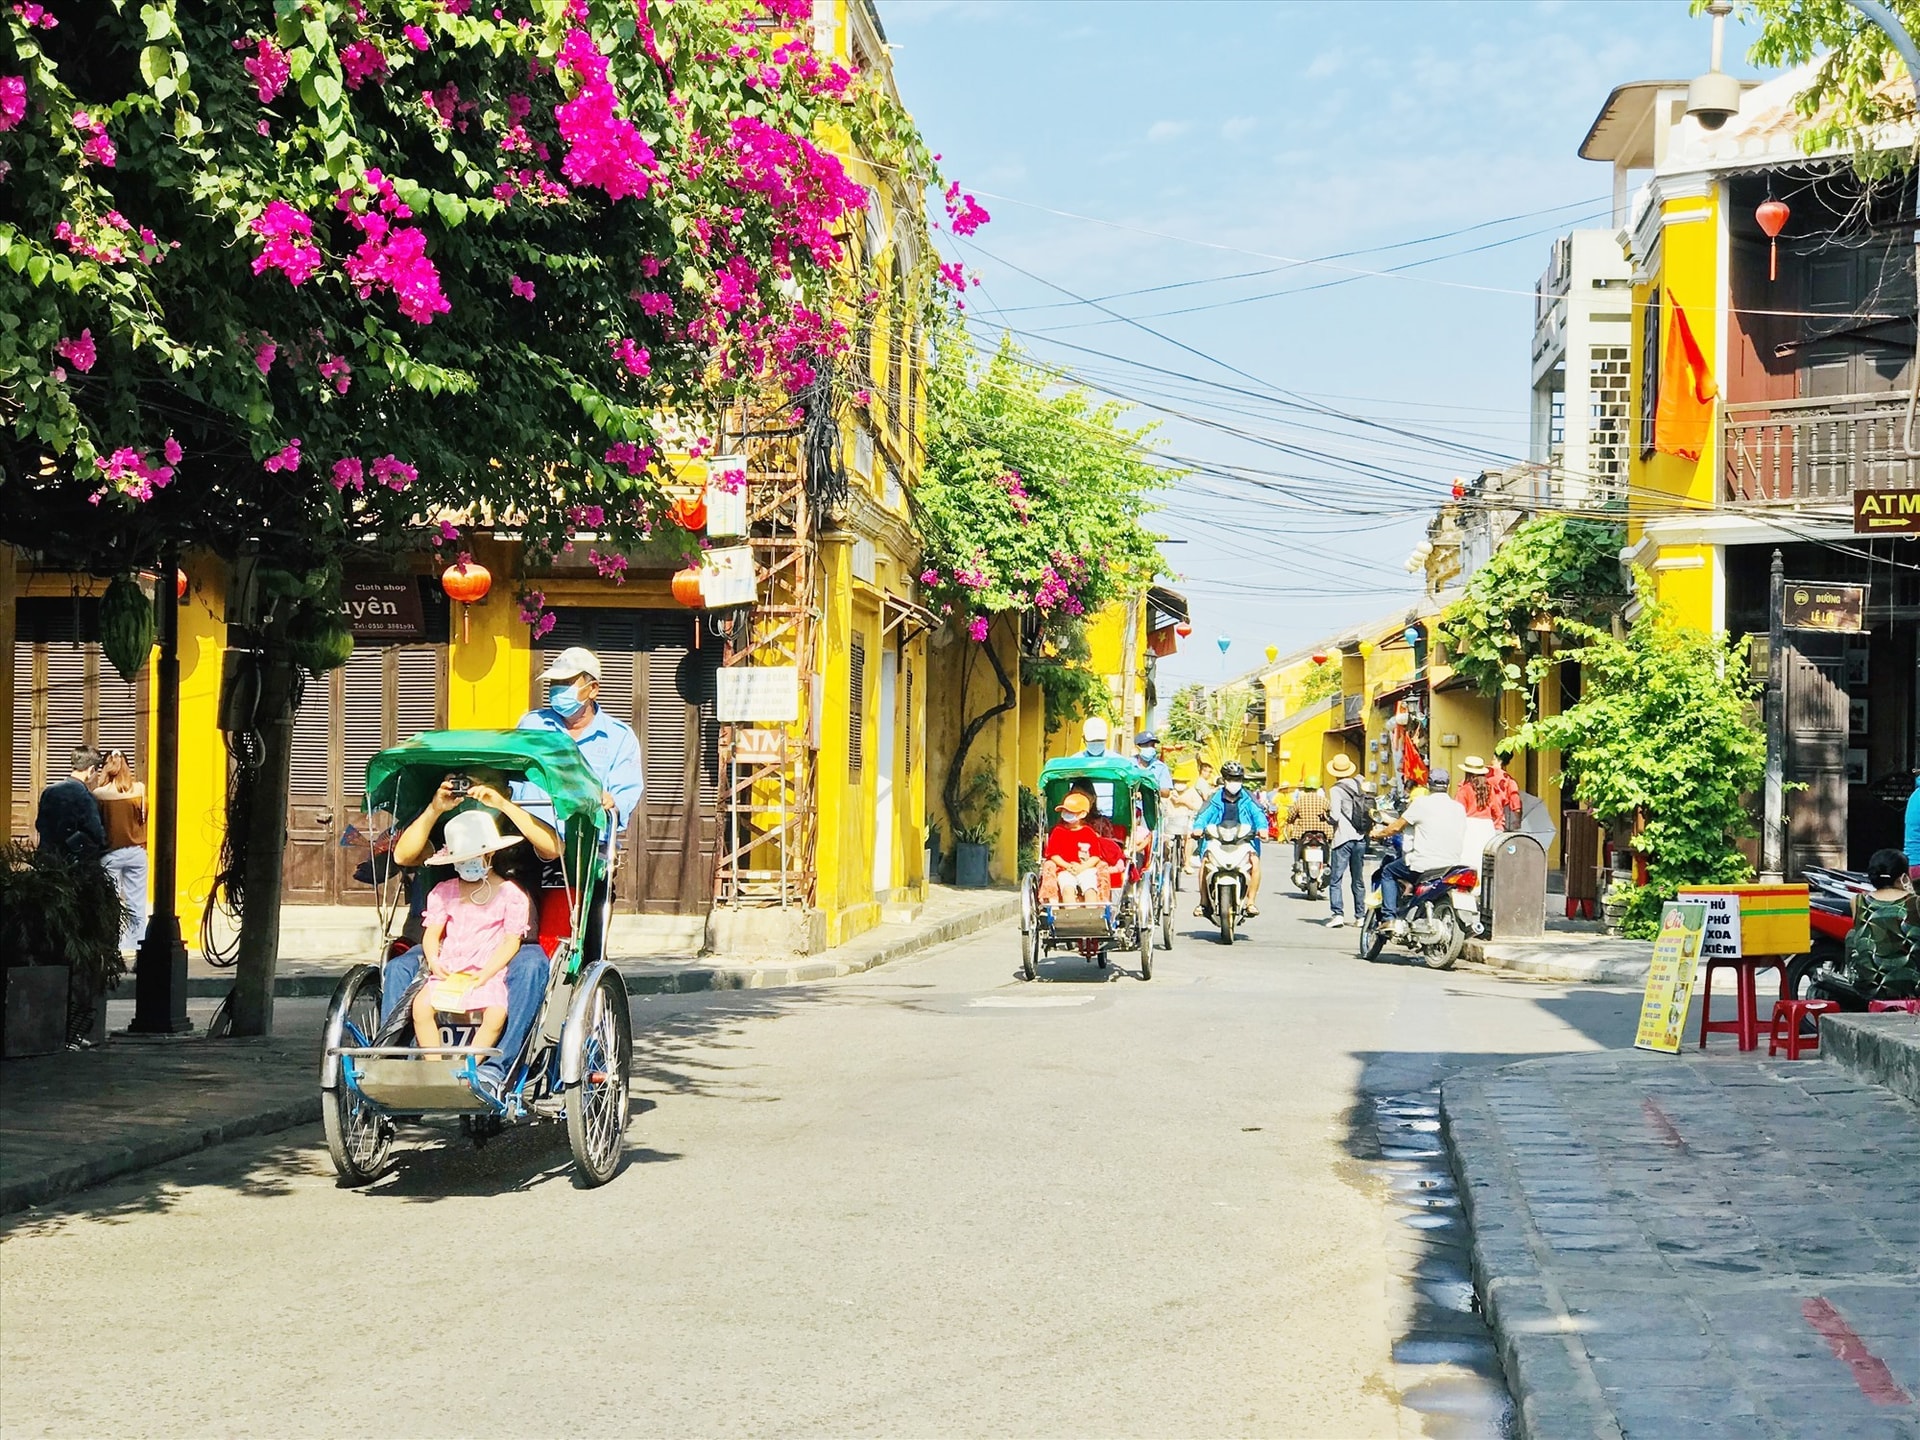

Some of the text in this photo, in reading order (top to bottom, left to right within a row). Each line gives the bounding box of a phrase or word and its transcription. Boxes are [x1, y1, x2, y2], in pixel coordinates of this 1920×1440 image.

[1859, 494, 1920, 515] ATM
[354, 583, 407, 592] Cloth shop
[338, 595, 398, 620] uyên
[735, 731, 784, 753] ATM
[1707, 930, 1731, 940] XOA
[1704, 943, 1737, 954] XIÊM
